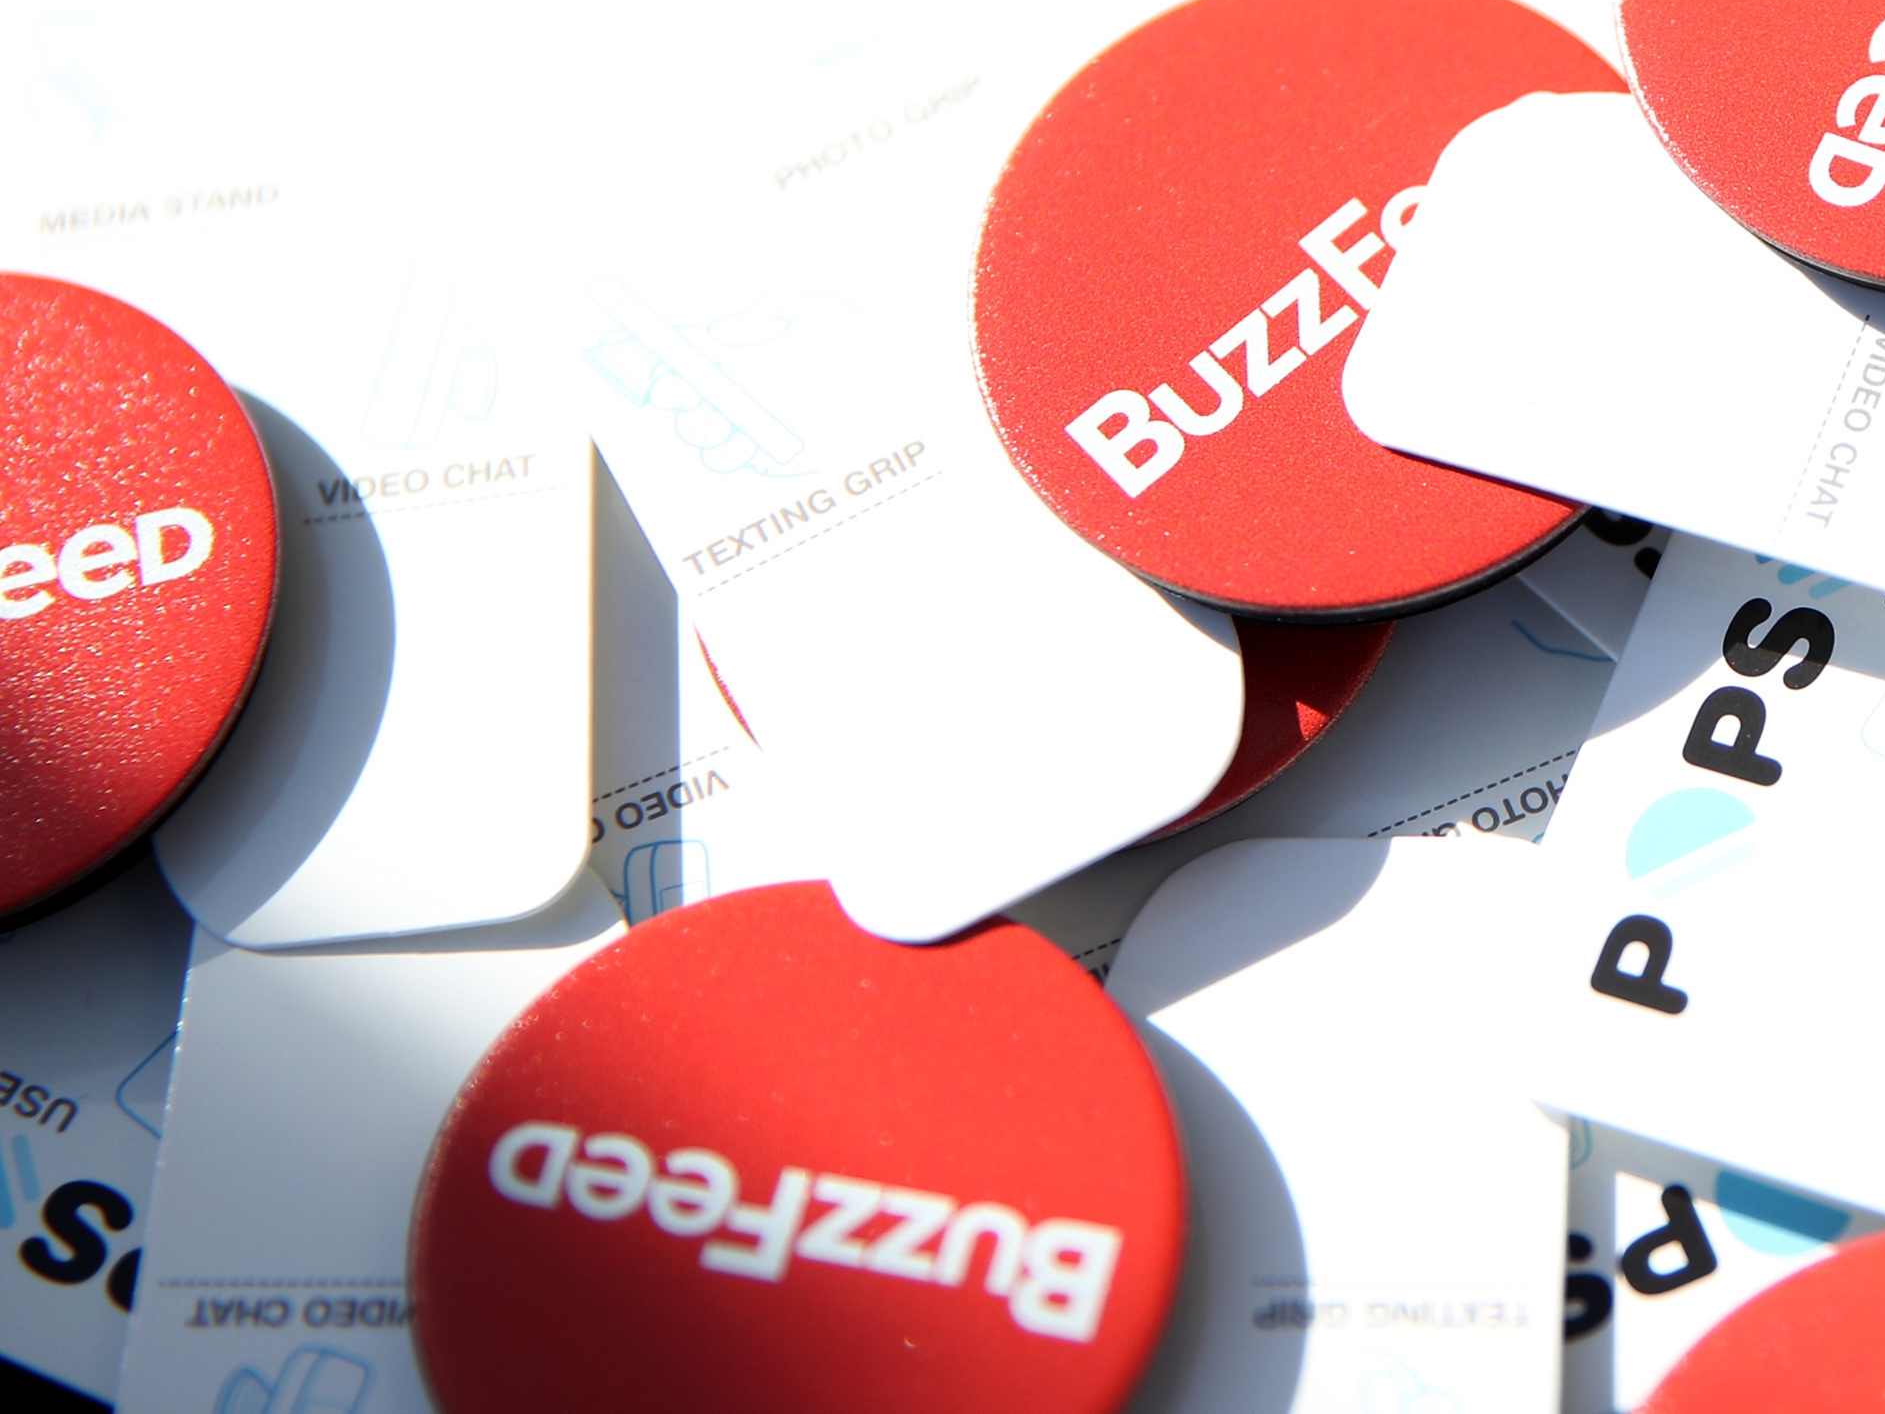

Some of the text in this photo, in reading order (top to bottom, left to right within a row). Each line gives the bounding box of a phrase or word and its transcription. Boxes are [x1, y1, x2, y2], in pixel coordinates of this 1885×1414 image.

[318, 453, 537, 508] VIDEO CHAT
[685, 441, 928, 578] TEXTING GRIP
[1806, 442, 1867, 528] CHAT
[615, 770, 729, 829] VIDEO
[187, 1298, 289, 1327] CHAT
